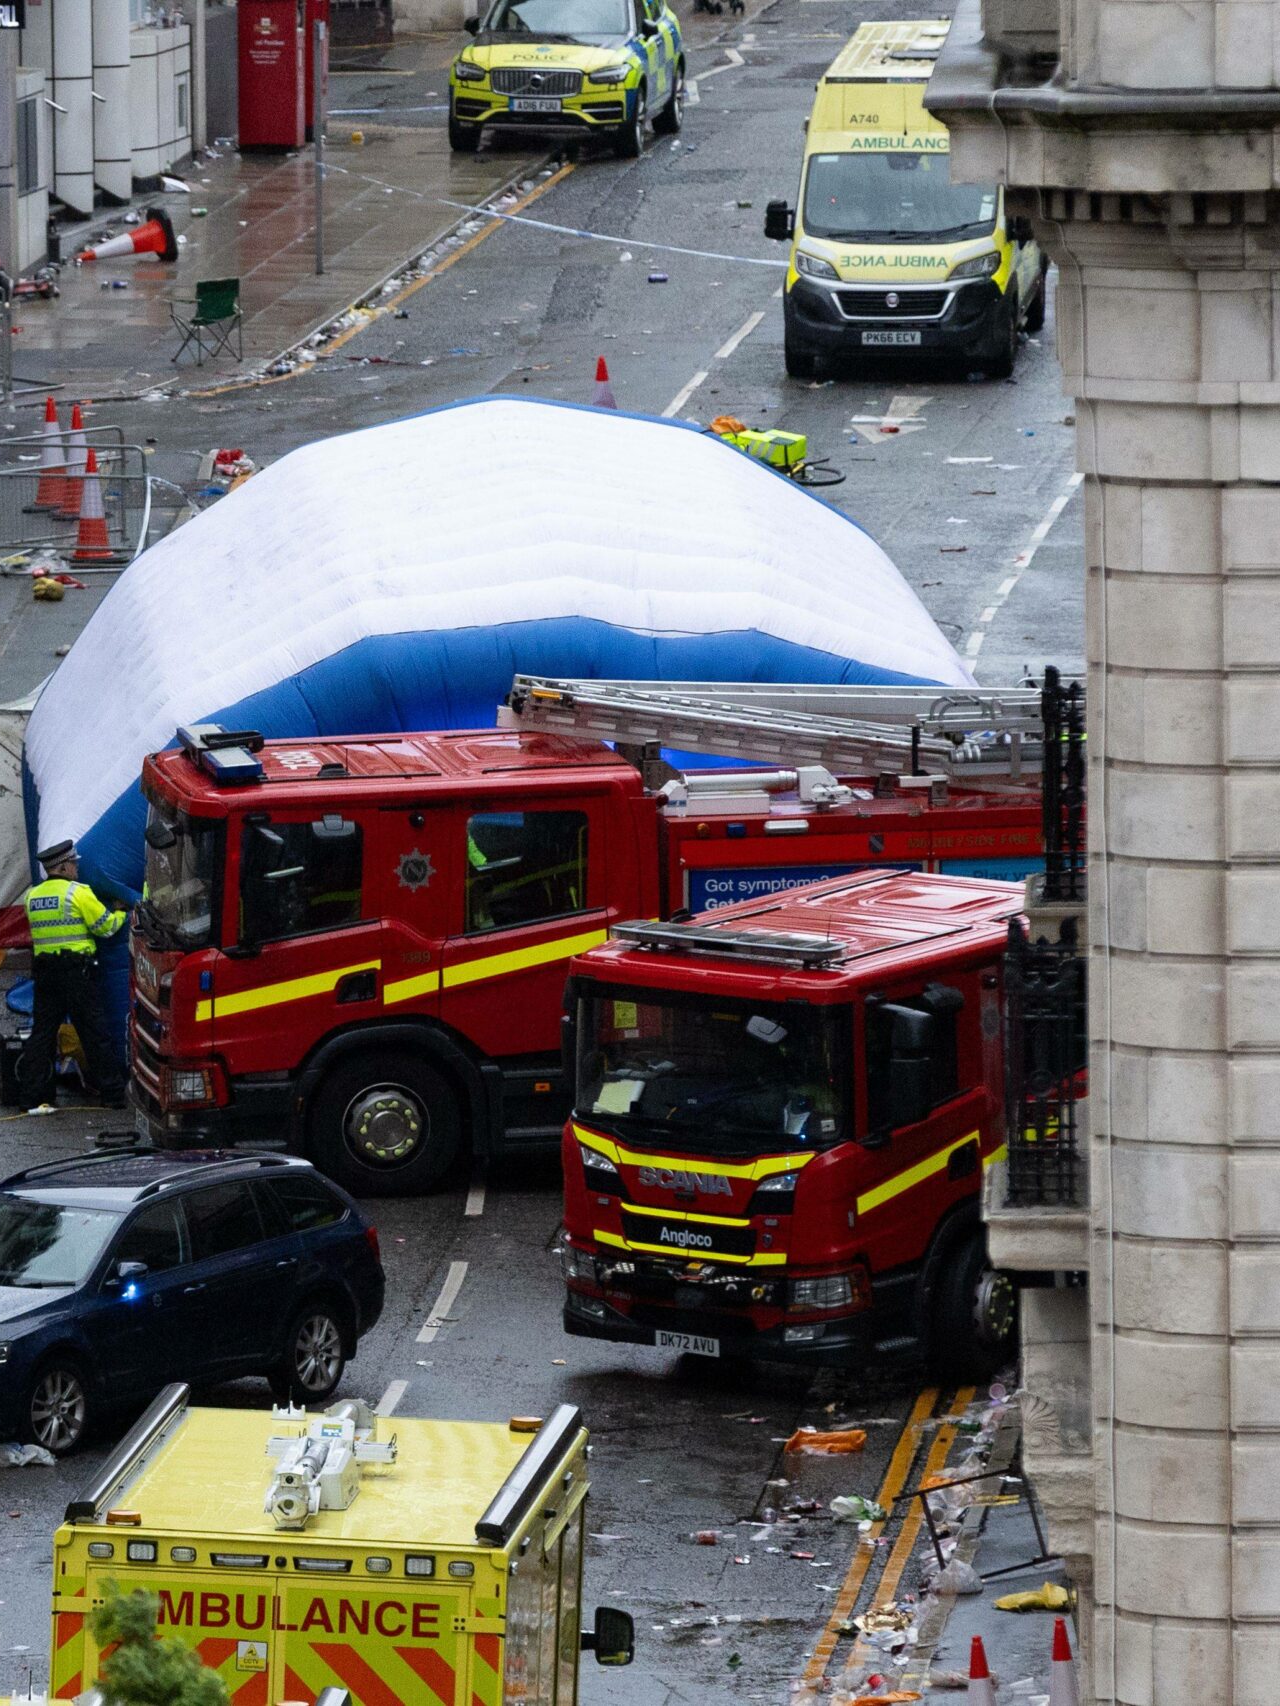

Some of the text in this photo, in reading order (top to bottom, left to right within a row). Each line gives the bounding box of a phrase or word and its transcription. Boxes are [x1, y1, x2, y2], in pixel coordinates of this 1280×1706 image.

[849, 115, 879, 124] A740
[851, 138, 950, 150] AMBULANC
[865, 333, 917, 343] PK66 ECV
[705, 878, 734, 892] Got
[31, 897, 58, 910] POLICE
[638, 1166, 733, 1197] SCANIA
[660, 1226, 712, 1247] Angloco
[660, 1333, 715, 1354] DK72 AVU
[157, 1590, 440, 1639] MBULANCE
